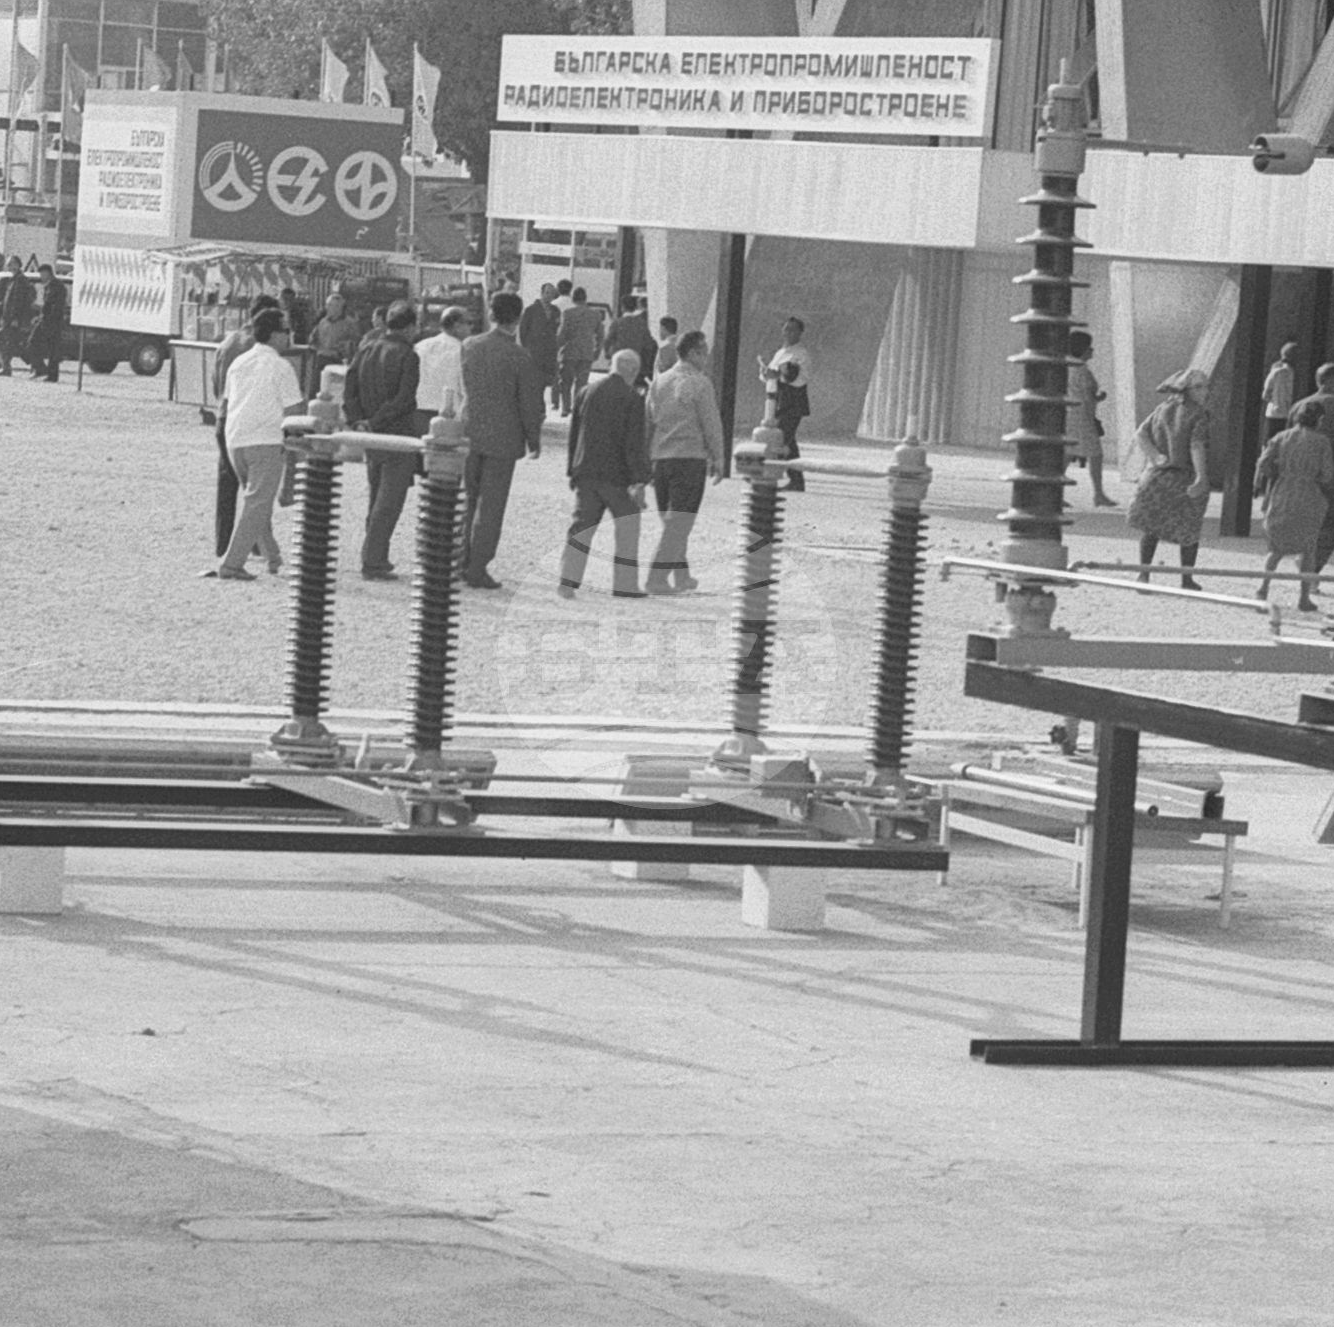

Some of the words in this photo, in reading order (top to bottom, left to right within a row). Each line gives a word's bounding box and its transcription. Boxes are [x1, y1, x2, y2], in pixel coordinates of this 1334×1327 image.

[680, 52, 972, 80] ЕЛЕКТРОПРОМИШЛЕНОСТ
[504, 84, 721, 112] РАДИОЕЛЕКТРОНИКА
[730, 90, 744, 112] И
[753, 90, 967, 118] ПРИБОРОСТРОЕНЕ
